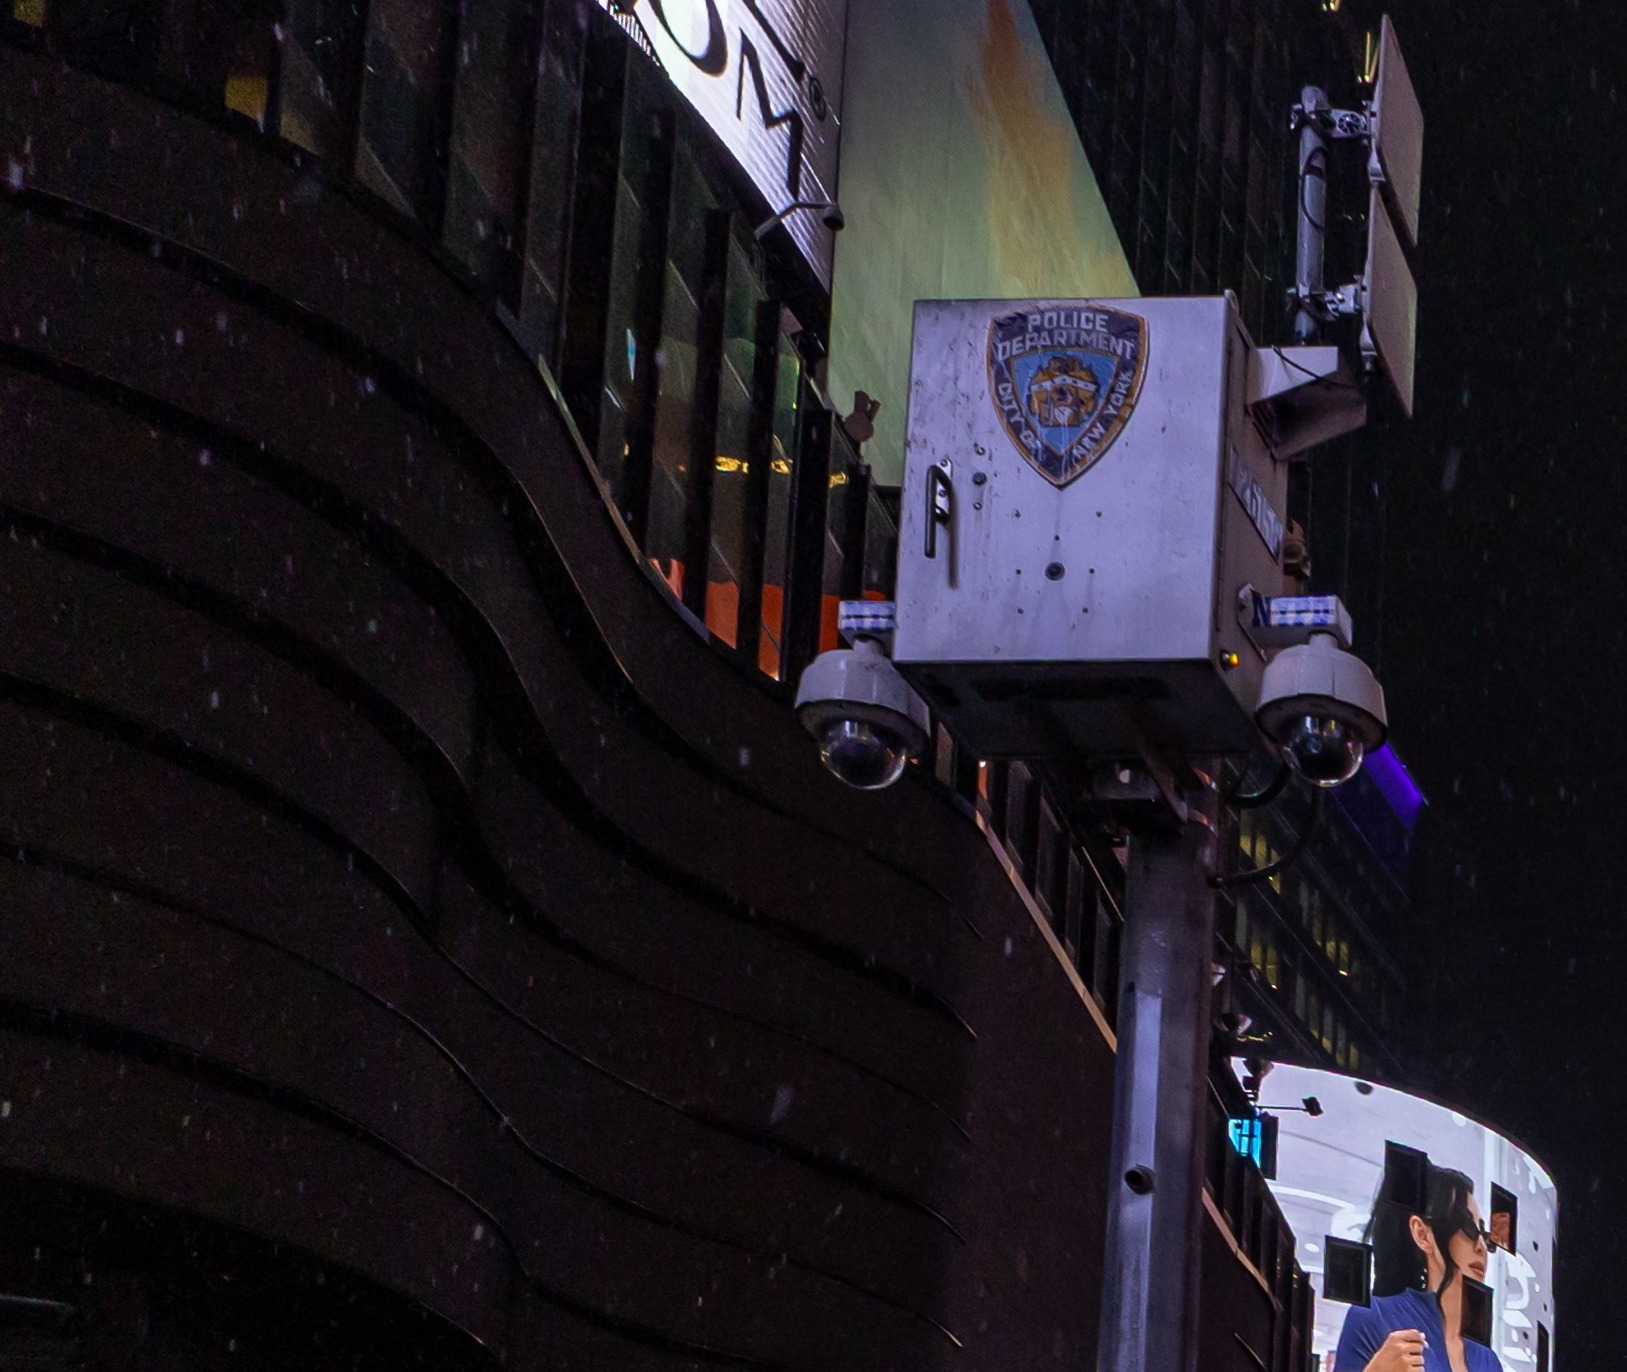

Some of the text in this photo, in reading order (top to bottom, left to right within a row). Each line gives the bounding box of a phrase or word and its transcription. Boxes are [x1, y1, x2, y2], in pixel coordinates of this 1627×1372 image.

[1028, 311, 1109, 333] POLICE
[997, 329, 1135, 361] DEPARTMENT
[1103, 370, 1134, 421] YORK
